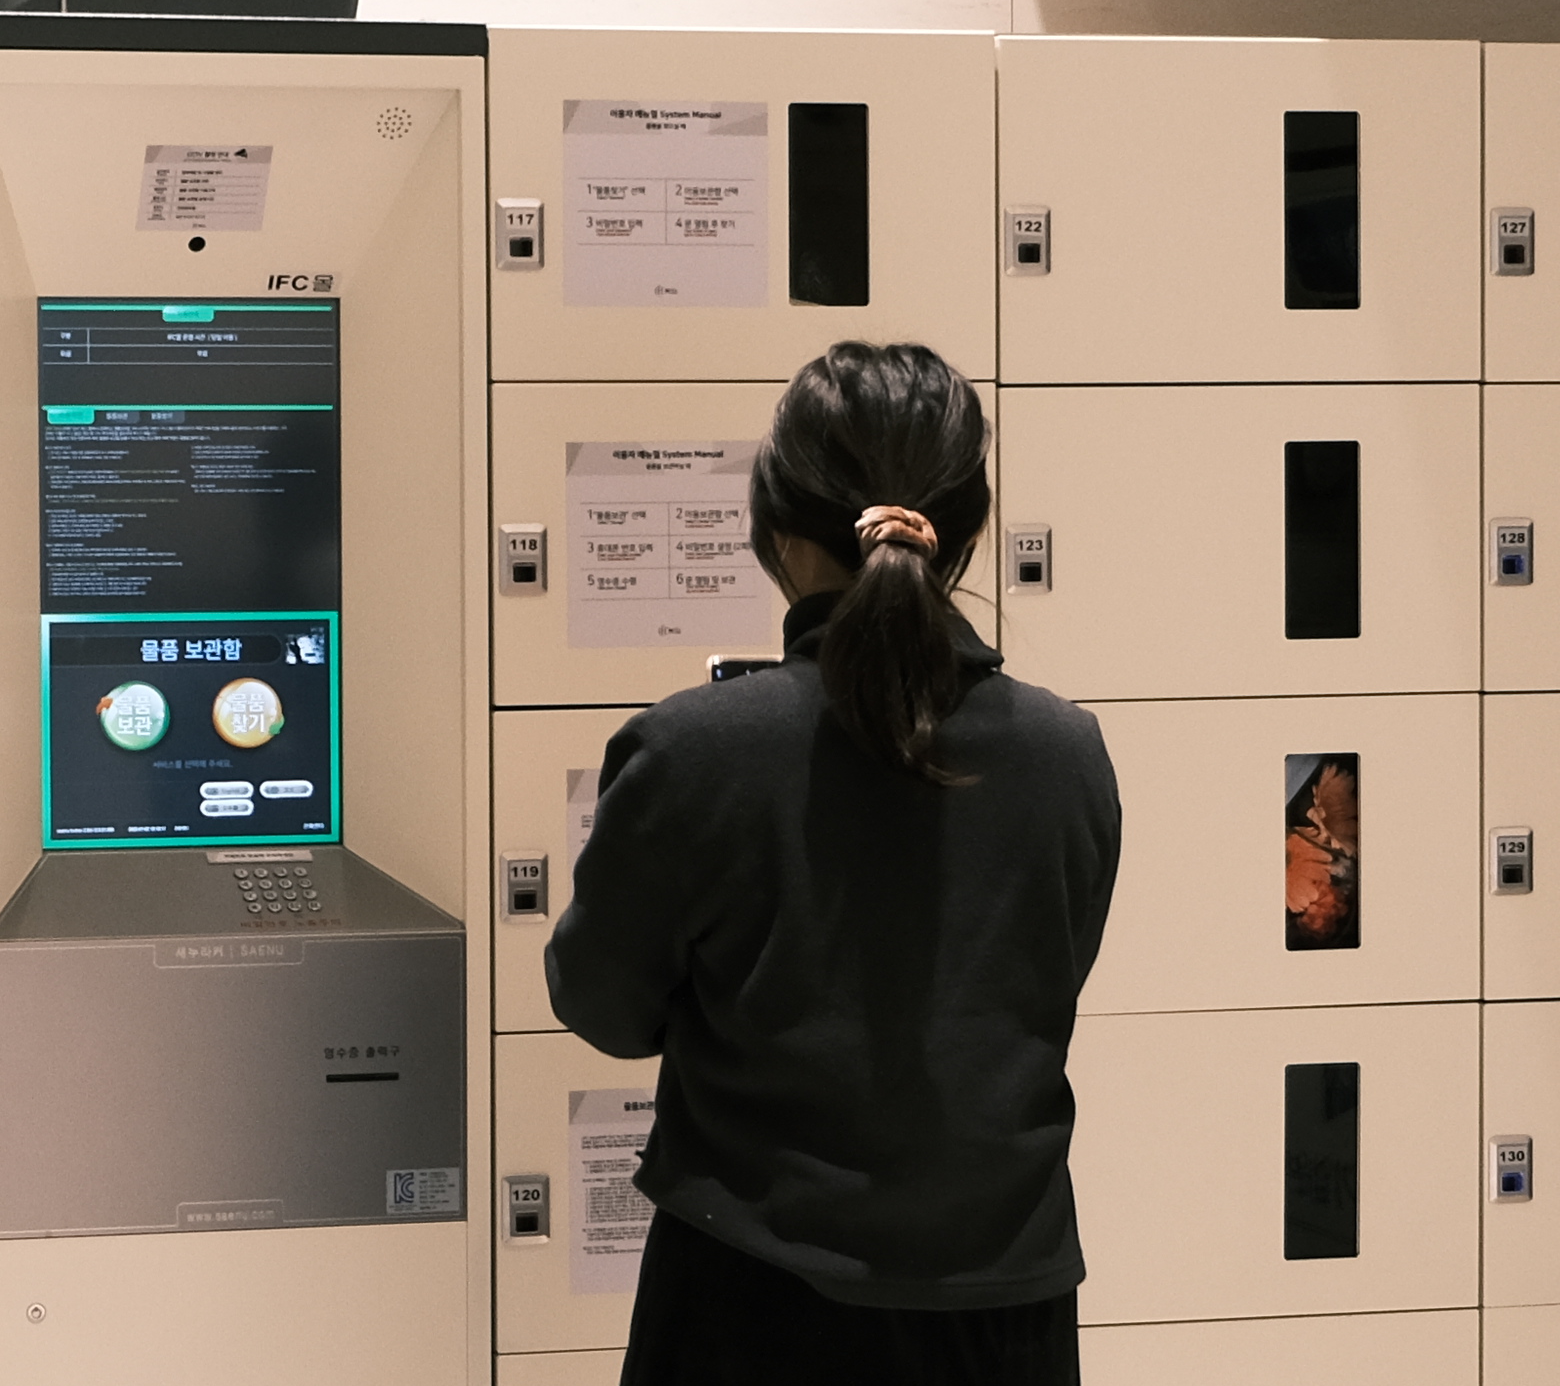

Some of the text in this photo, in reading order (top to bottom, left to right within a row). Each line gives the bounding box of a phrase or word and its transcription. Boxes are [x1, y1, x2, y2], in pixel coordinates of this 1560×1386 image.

[660, 110, 690, 120] System
[692, 110, 722, 119] Manual
[675, 184, 682, 196] 2
[507, 215, 534, 225] 117
[586, 216, 593, 228] 3
[675, 217, 683, 228] 4
[1016, 221, 1042, 231] 122
[1501, 223, 1526, 233] 127
[268, 275, 309, 291] IFC
[662, 450, 692, 459] System
[694, 449, 724, 458] Manual
[676, 508, 683, 519] 2
[1500, 533, 1524, 543] 128
[510, 540, 537, 551] 118
[587, 542, 594, 553] 3
[676, 541, 683, 551] 4
[1018, 540, 1043, 551] 123
[587, 574, 595, 586] 5
[676, 573, 683, 585] 6
[140, 638, 242, 662] 물품 보관함
[117, 695, 151, 715] 물품
[231, 693, 265, 713] 물품
[117, 716, 152, 736] 보관
[232, 714, 265, 733] 찾기
[1500, 843, 1525, 853] 129
[510, 867, 538, 877] 119
[240, 944, 284, 957] SAENU
[324, 1046, 359, 1059] 영수증
[1500, 1151, 1524, 1161] 130
[513, 1190, 540, 1201] 120
